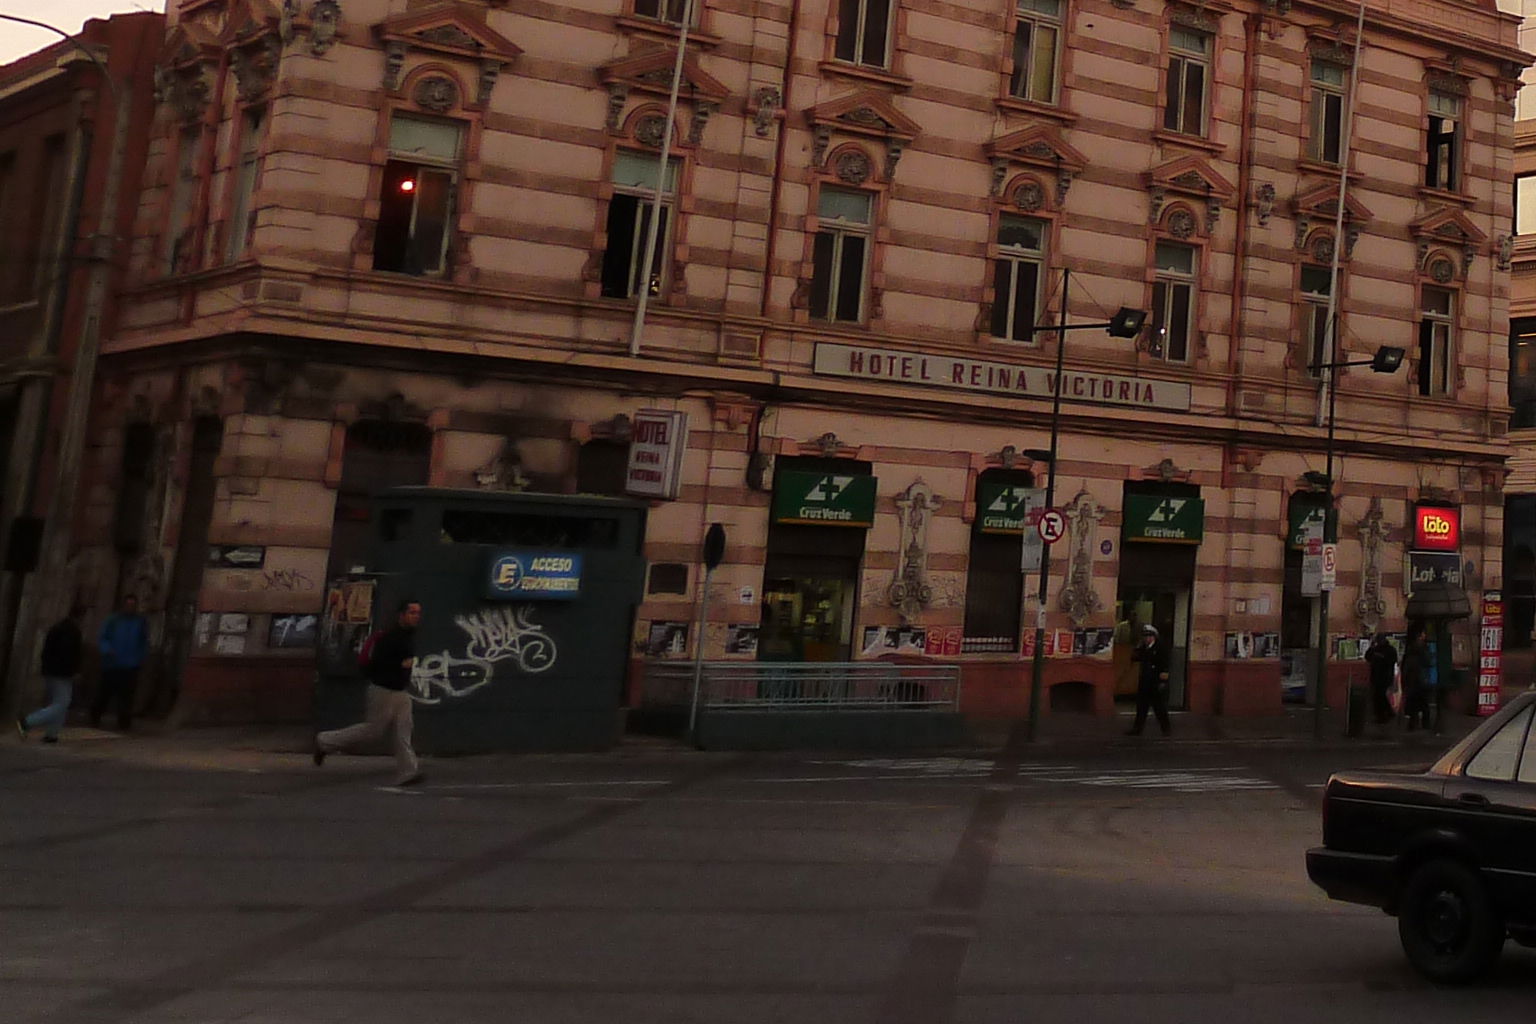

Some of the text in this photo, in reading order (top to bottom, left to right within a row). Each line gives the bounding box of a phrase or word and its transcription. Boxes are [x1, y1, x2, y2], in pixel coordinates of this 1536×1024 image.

[850, 351, 1153, 403] HOTEL REINA VICTORIA
[632, 419, 669, 446] HOTEL
[497, 563, 518, 585] E
[530, 557, 573, 572] ACCESO
